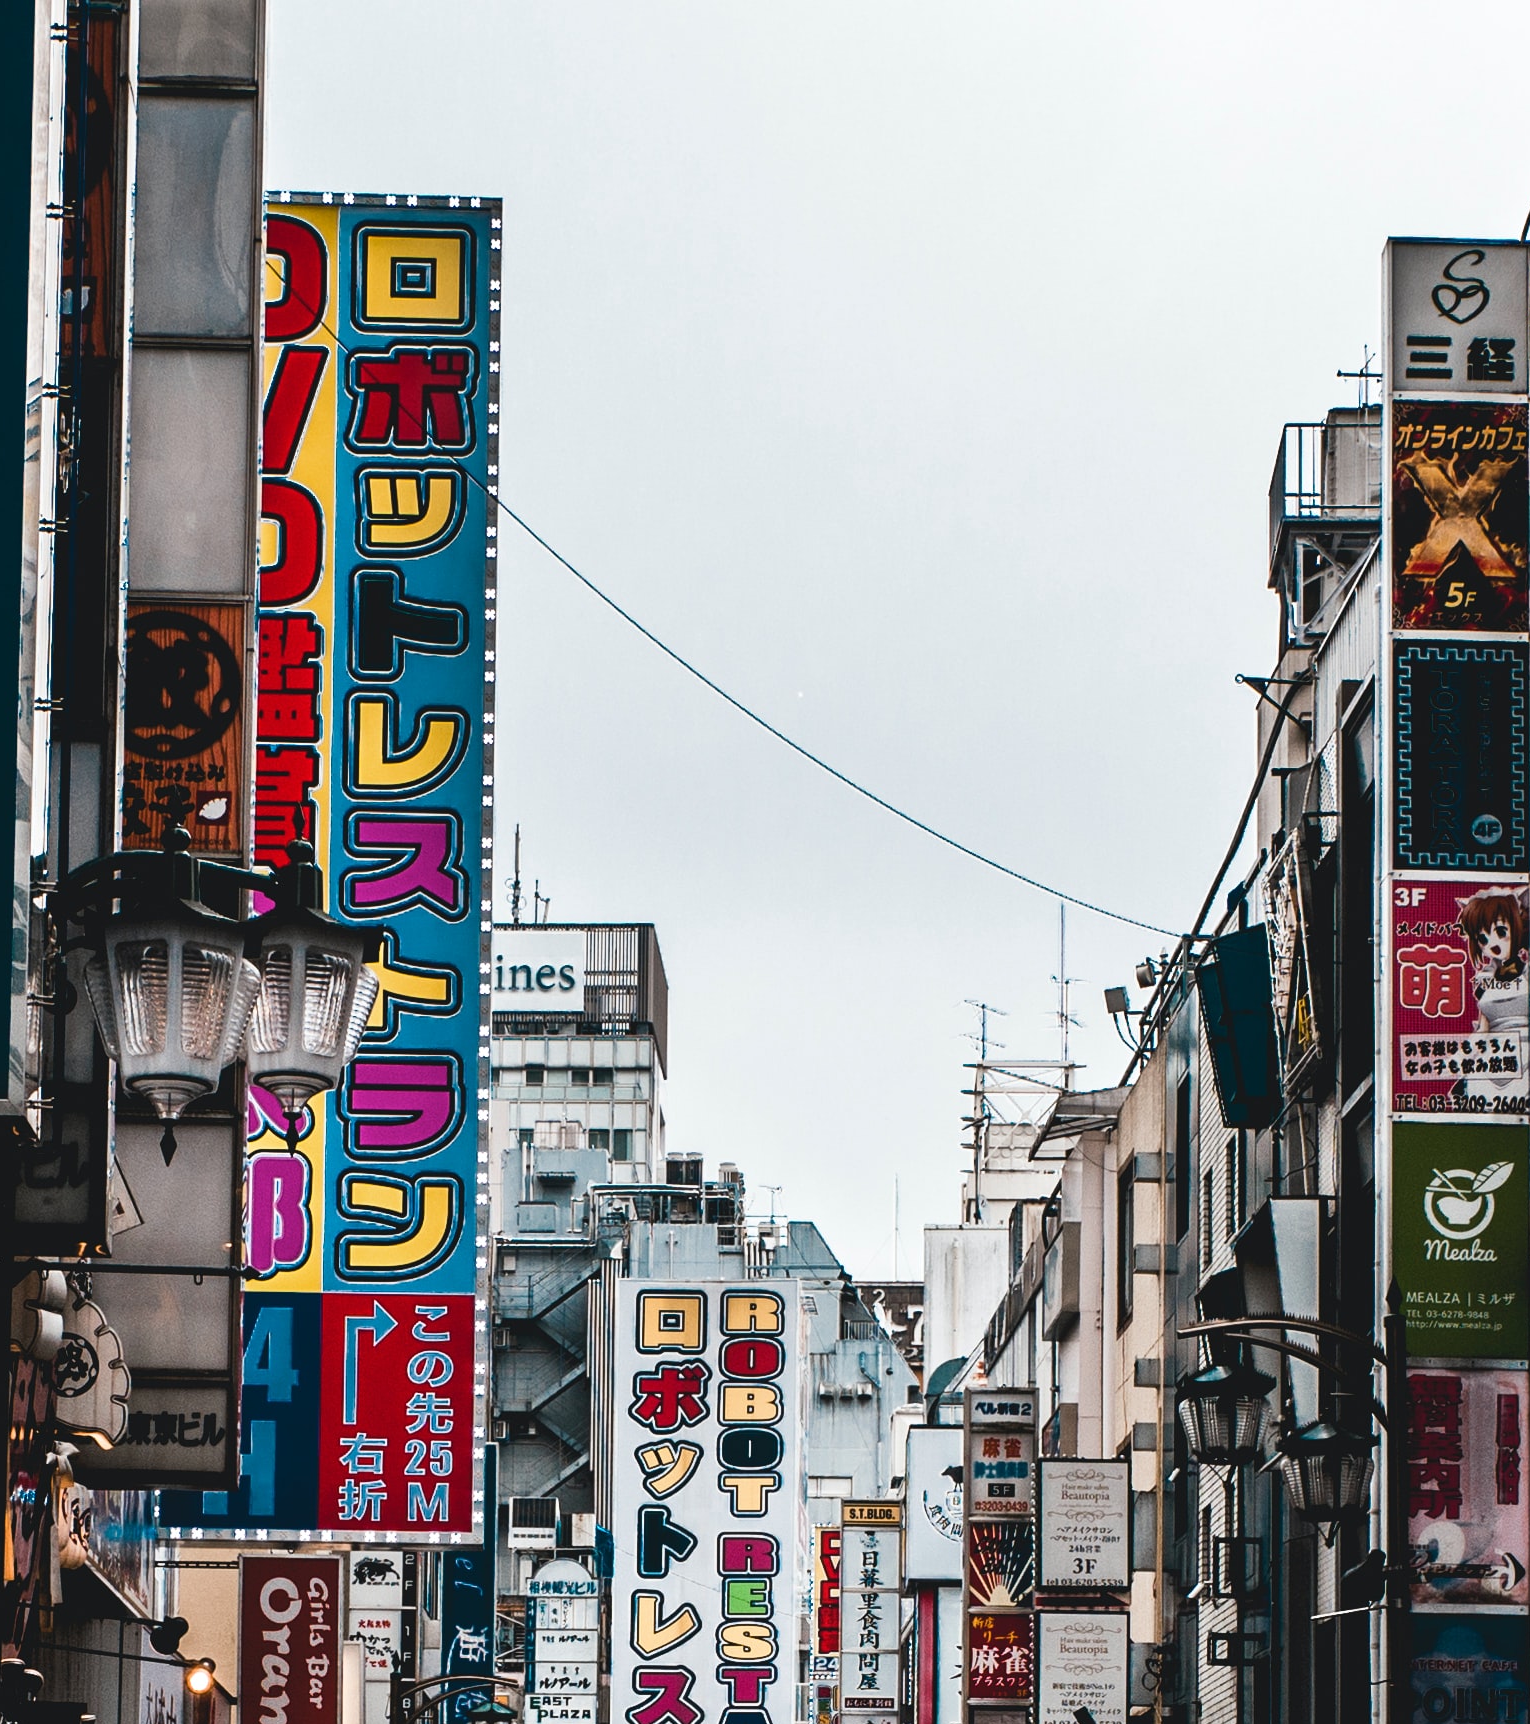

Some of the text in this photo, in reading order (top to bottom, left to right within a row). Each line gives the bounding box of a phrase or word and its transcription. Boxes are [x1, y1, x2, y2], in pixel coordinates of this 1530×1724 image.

[1406, 335, 1515, 381] 三経
[1395, 424, 1527, 452] オンラインカフェ
[1400, 453, 1517, 579] X
[1444, 581, 1476, 608] 5F
[334, 220, 481, 1282] ロボットレストラン
[1473, 822, 1500, 841] 4F
[1394, 888, 1428, 907] 3F
[1396, 943, 1468, 1017] 萌
[1404, 1037, 1516, 1056] お客様はもちろん
[1404, 1056, 1519, 1076] 女の子も飲み放題
[1423, 1237, 1498, 1264] Mealza
[1406, 1291, 1516, 1306] MEALZA ミルザ
[1406, 1310, 1490, 1320] TEL 03-6278-9848
[406, 1303, 455, 1523] この先25M
[717, 1288, 785, 1518] ROBOT
[983, 1437, 1022, 1459] 麻雀
[338, 1432, 389, 1522] 右折
[992, 1485, 1011, 1496] 5F
[1061, 1490, 1110, 1503] Beautopia
[849, 1509, 896, 1520] S.T.BLDG.
[1073, 1559, 1098, 1575] 3F
[856, 1551, 884, 1691] 日暮里食肉問屋
[305, 1577, 332, 1710] Girls Bar
[983, 1631, 1019, 1644] リーチ
[971, 1644, 1030, 1675] 麻雀
[1060, 1643, 1109, 1657] Beautopia
[539, 1676, 591, 1690] ルノアール
[529, 1696, 591, 1723] EAST PLAZA
